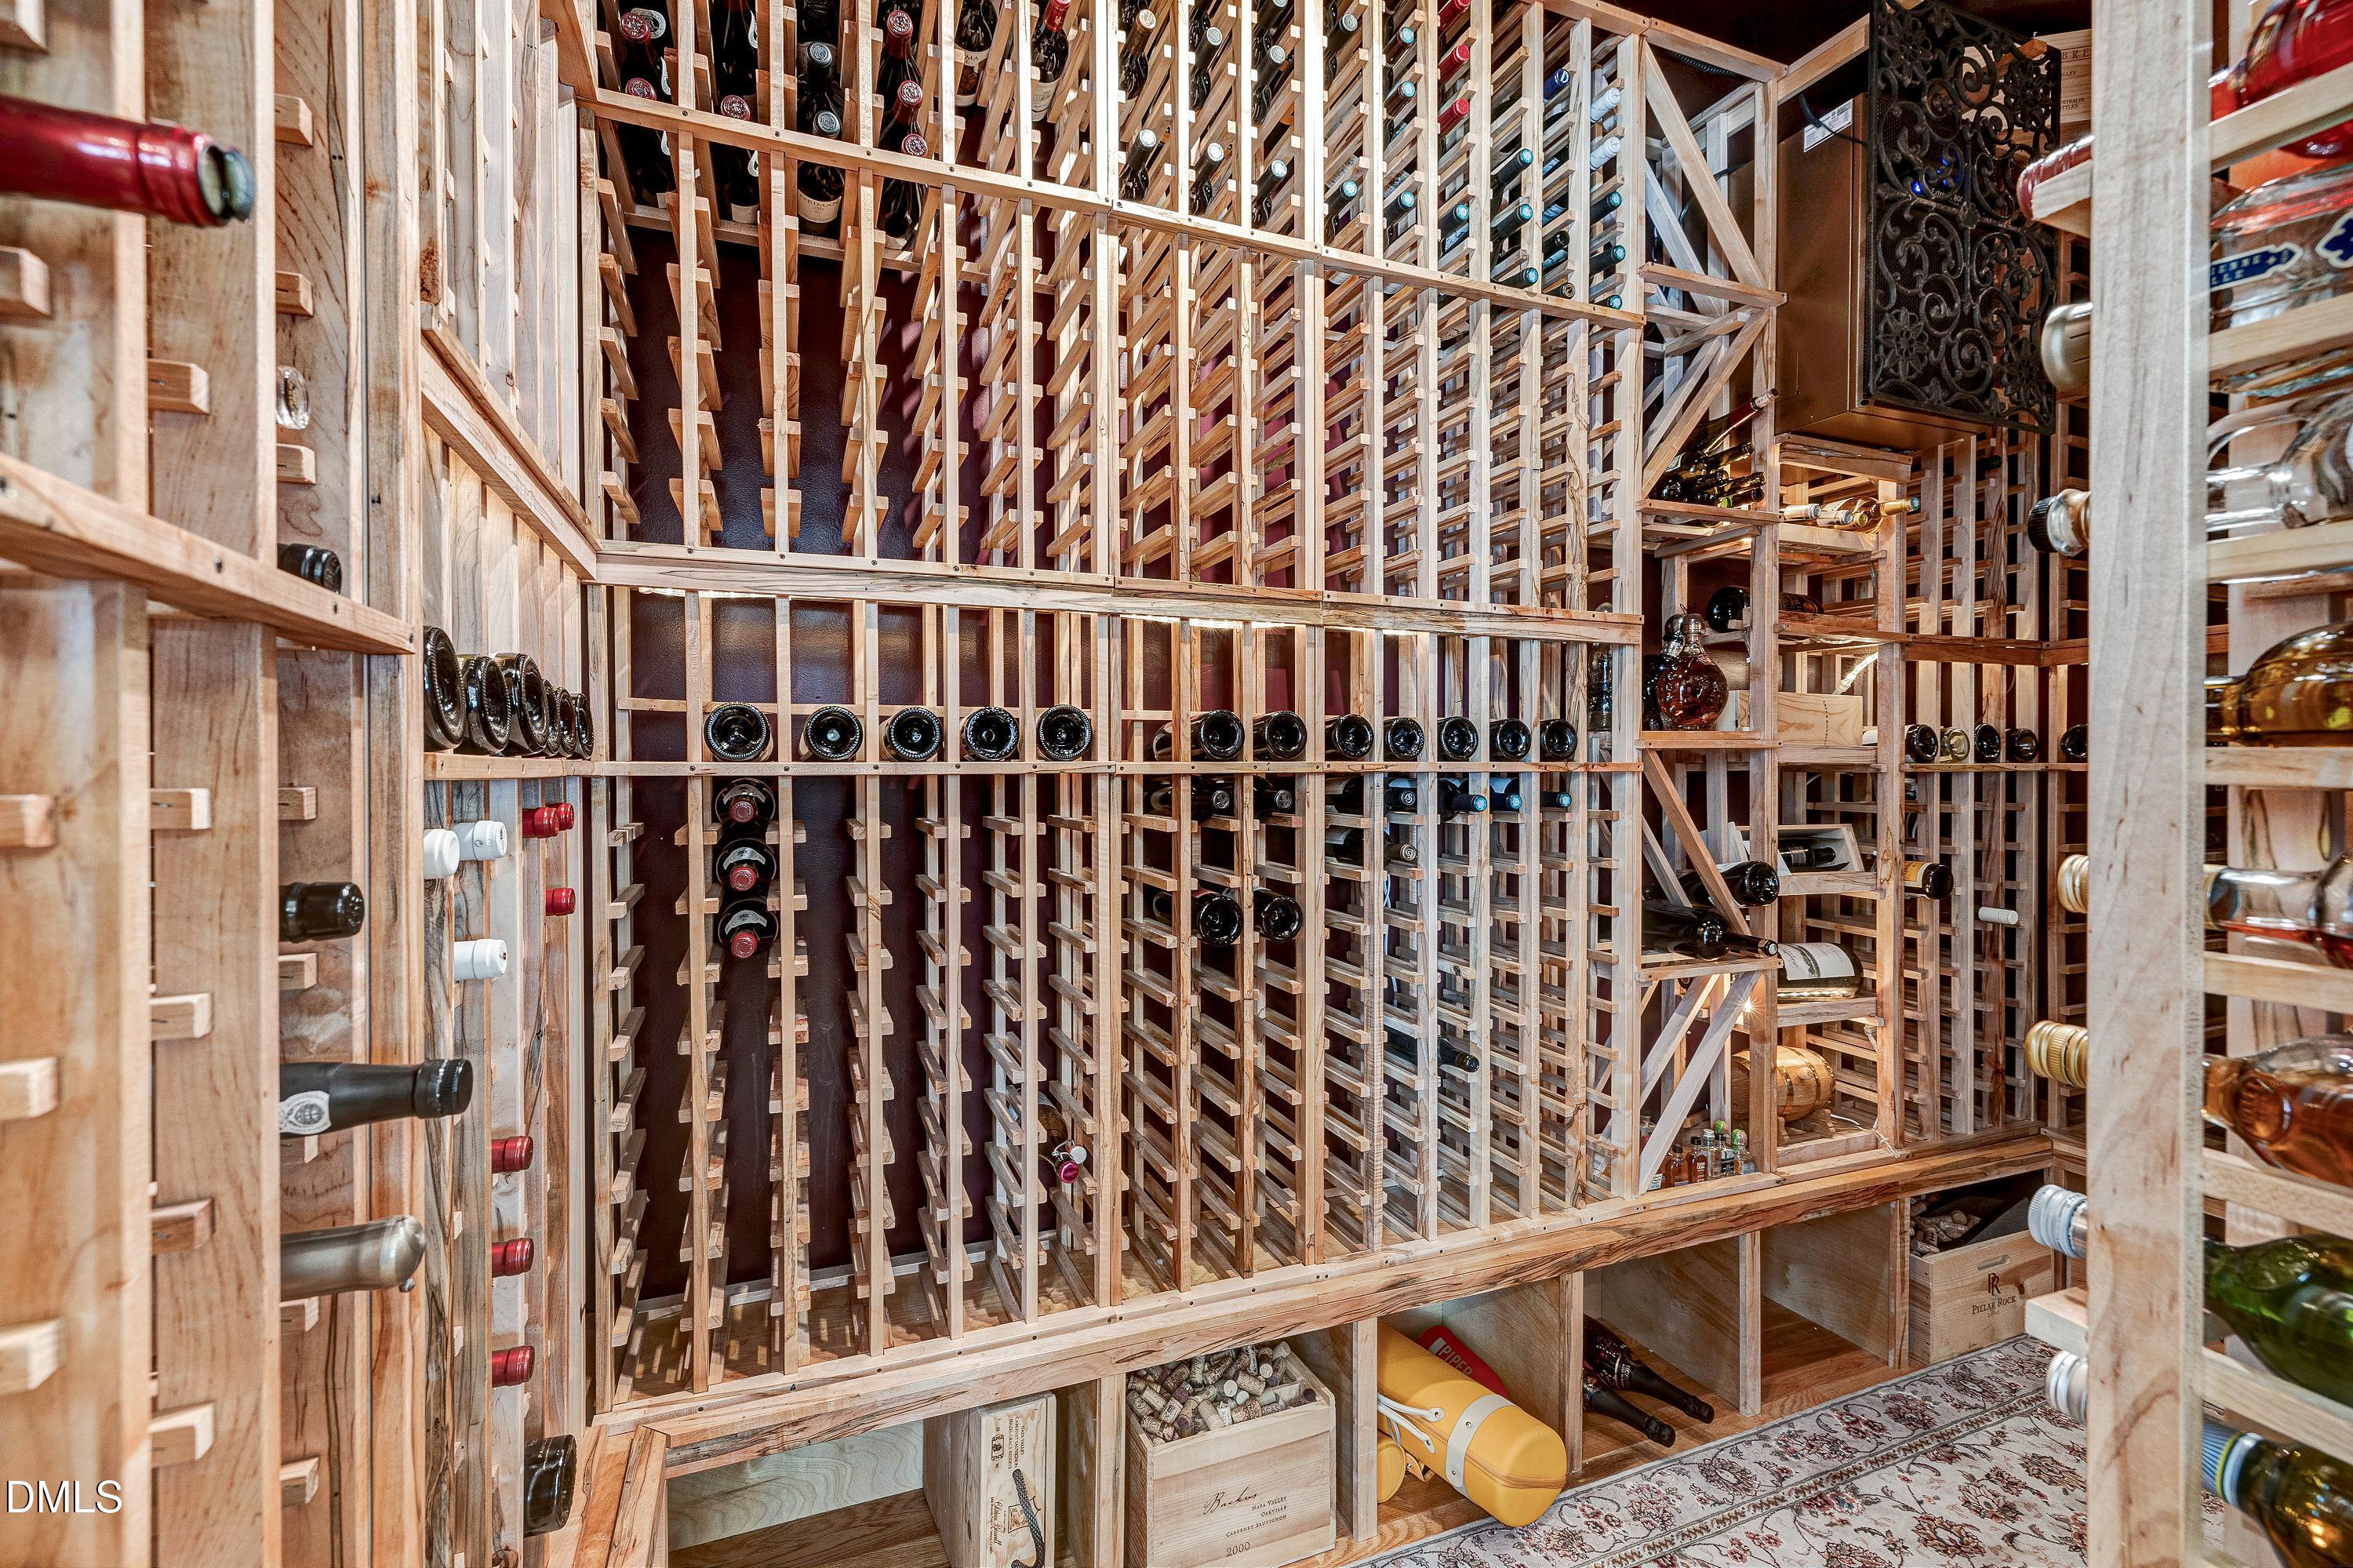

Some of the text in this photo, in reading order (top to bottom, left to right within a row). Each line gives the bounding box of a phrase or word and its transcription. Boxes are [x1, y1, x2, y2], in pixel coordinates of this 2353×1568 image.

[1997, 1295, 2017, 1308] ROCK
[1252, 1496, 1287, 1512] NAPA VALLEY
[1260, 1504, 1287, 1517] OAKVILLE
[1226, 1514, 1287, 1537] CABERNET SAUVIGNON
[1226, 1541, 1250, 1558] 2000
